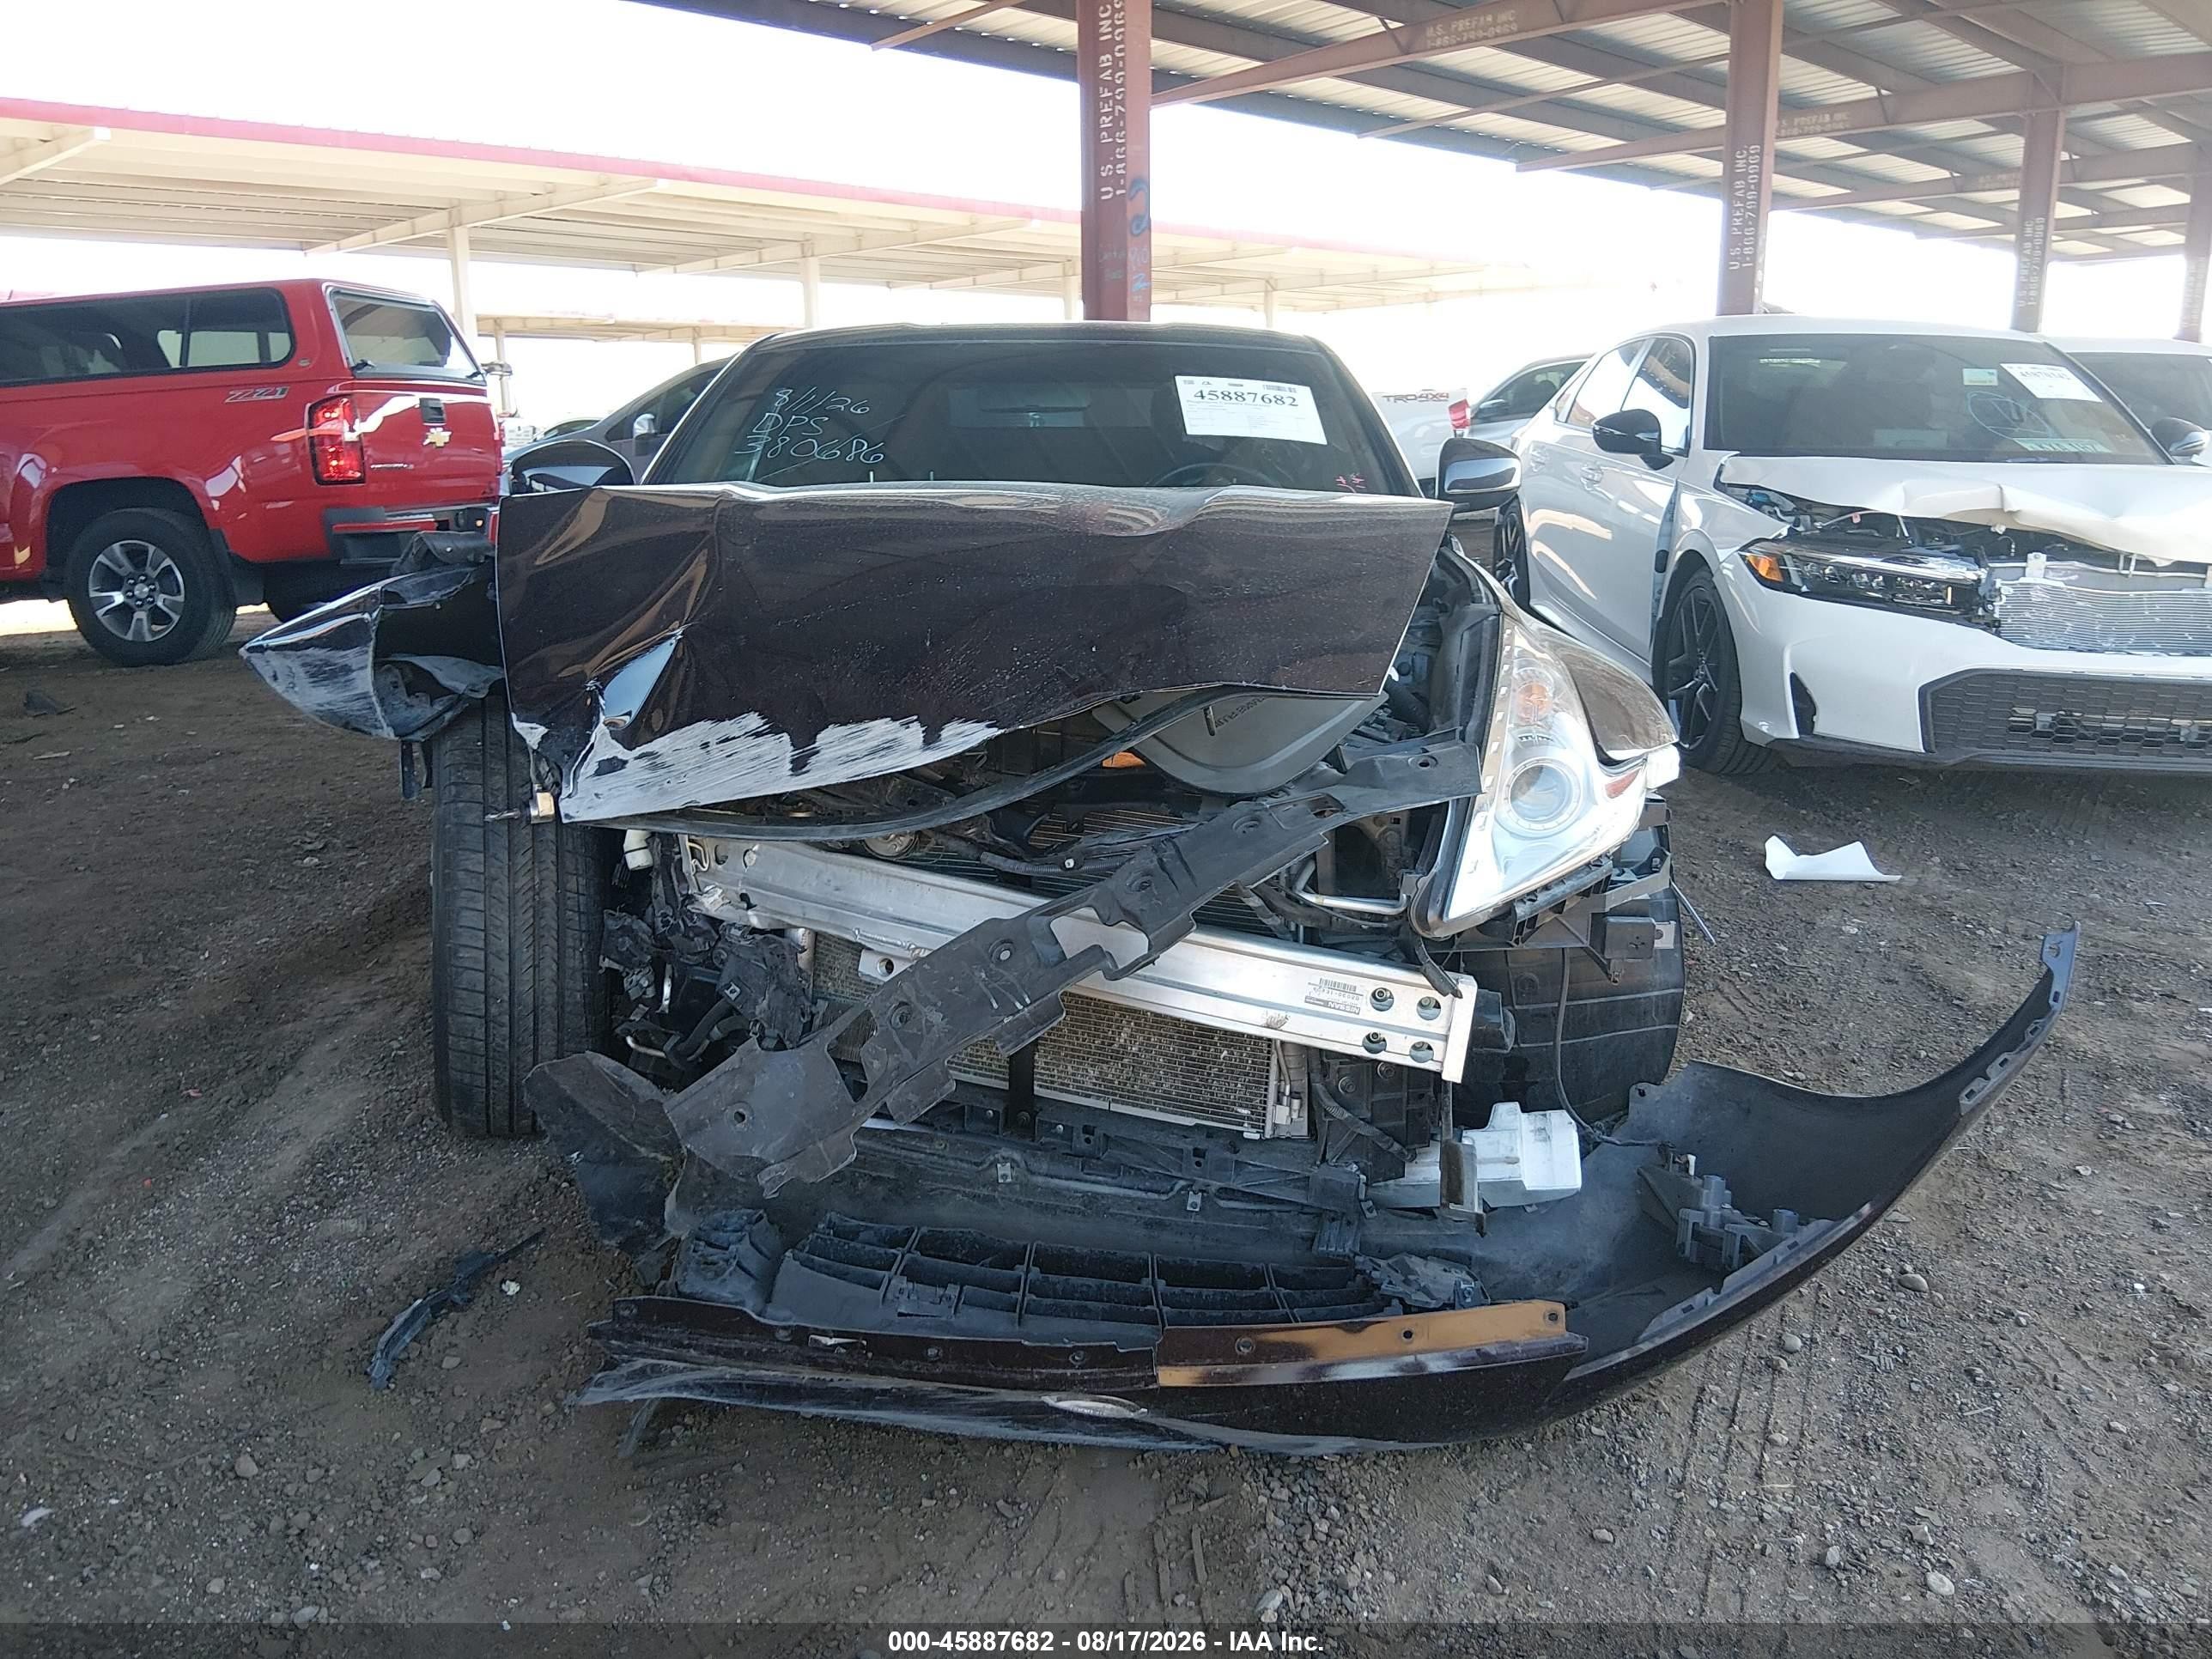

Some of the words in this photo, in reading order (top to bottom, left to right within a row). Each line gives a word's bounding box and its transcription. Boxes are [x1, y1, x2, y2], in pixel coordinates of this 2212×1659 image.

[1099, 53, 1114, 143] PREFAB
[1731, 180, 1746, 234] PREFAB
[225, 386, 289, 403] Z71
[1194, 389, 1299, 407] 45887682
[752, 412, 829, 436] DPS
[1328, 1001, 1359, 1014] NISSAN
